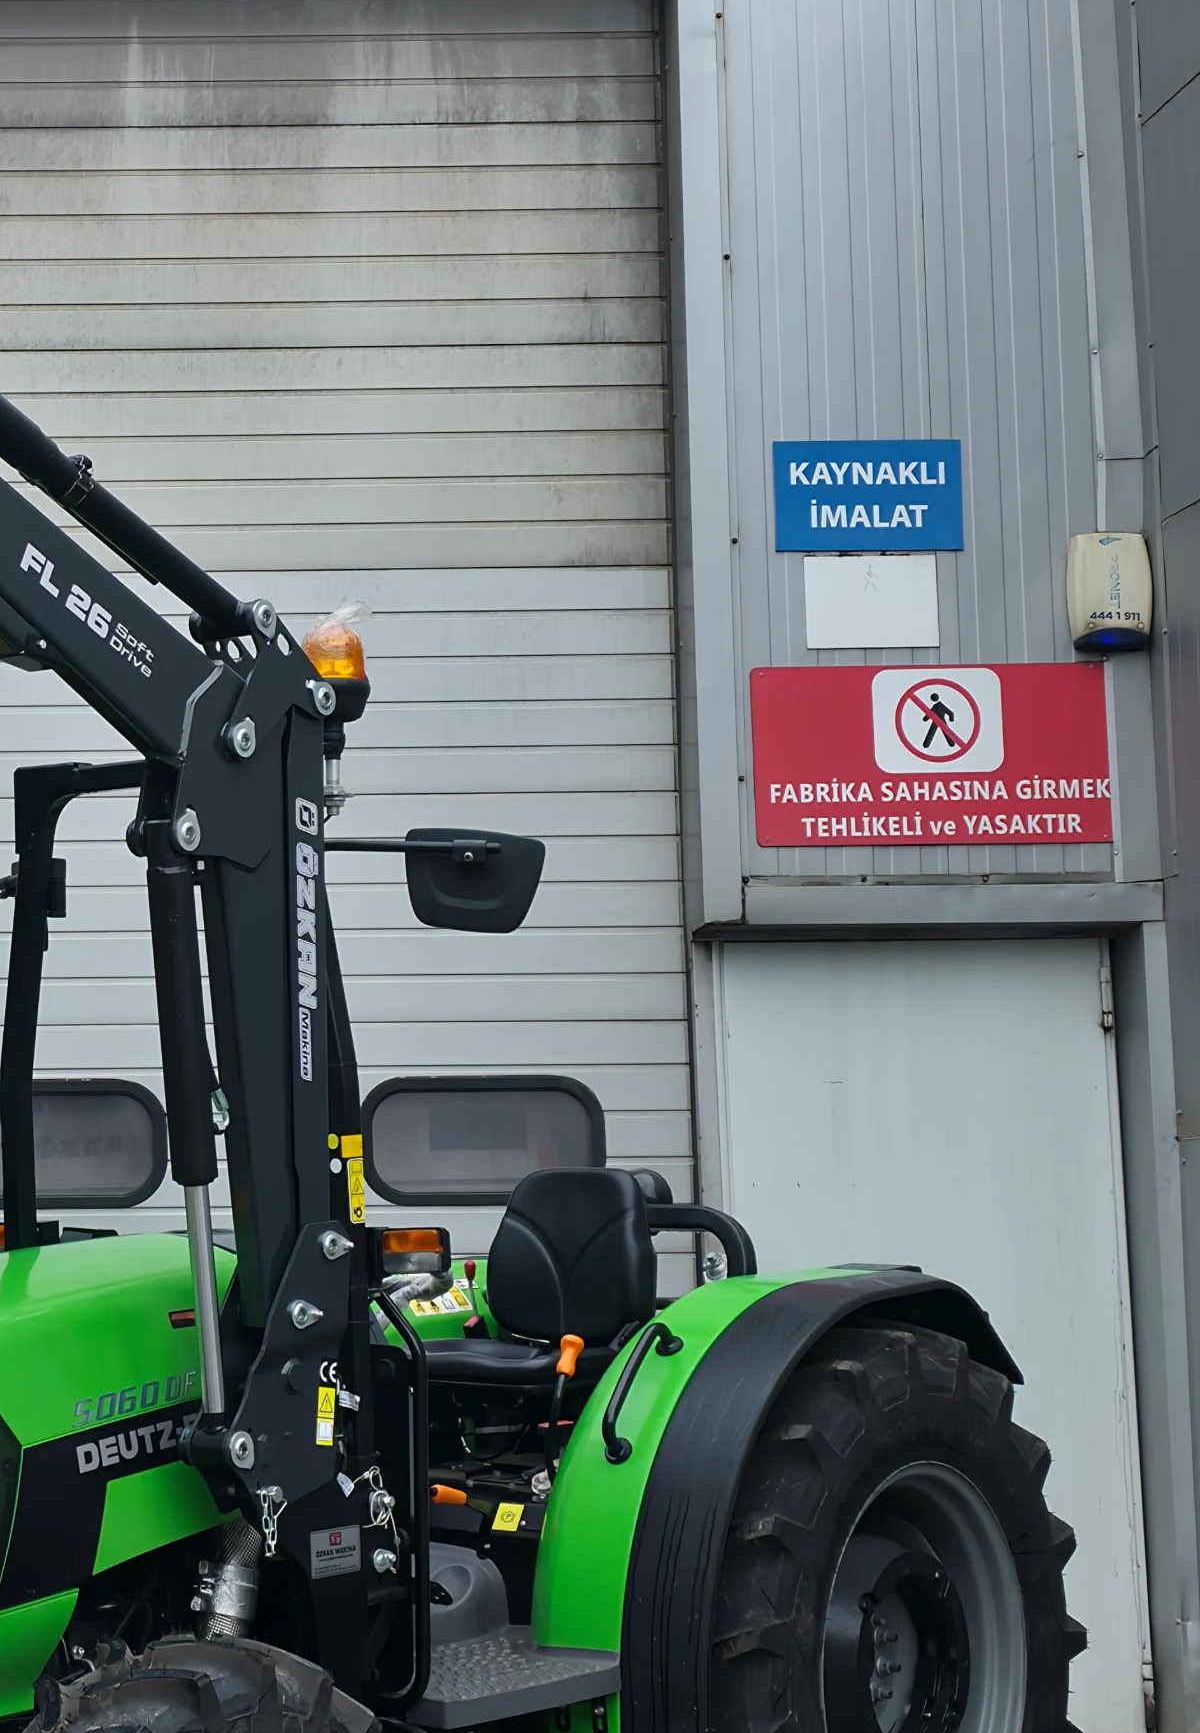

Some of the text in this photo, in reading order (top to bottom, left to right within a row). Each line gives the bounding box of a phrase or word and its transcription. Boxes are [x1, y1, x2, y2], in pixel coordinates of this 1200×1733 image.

[788, 461, 946, 486] KAYNAKLI
[810, 499, 929, 529] İMALAT
[20, 542, 112, 639] FL 26
[1090, 611, 1140, 621] 444 1 911
[109, 635, 152, 678] Drive
[115, 623, 154, 662] Soft
[770, 775, 1112, 804] FABRİKA SAHASINA GİRMEK
[801, 811, 1083, 837] TEHLİKELİ ve YASAKTIR
[296, 841, 319, 1010] ÖZKAN
[301, 1011, 310, 1077] Makina
[72, 1381, 160, 1428] 5060
